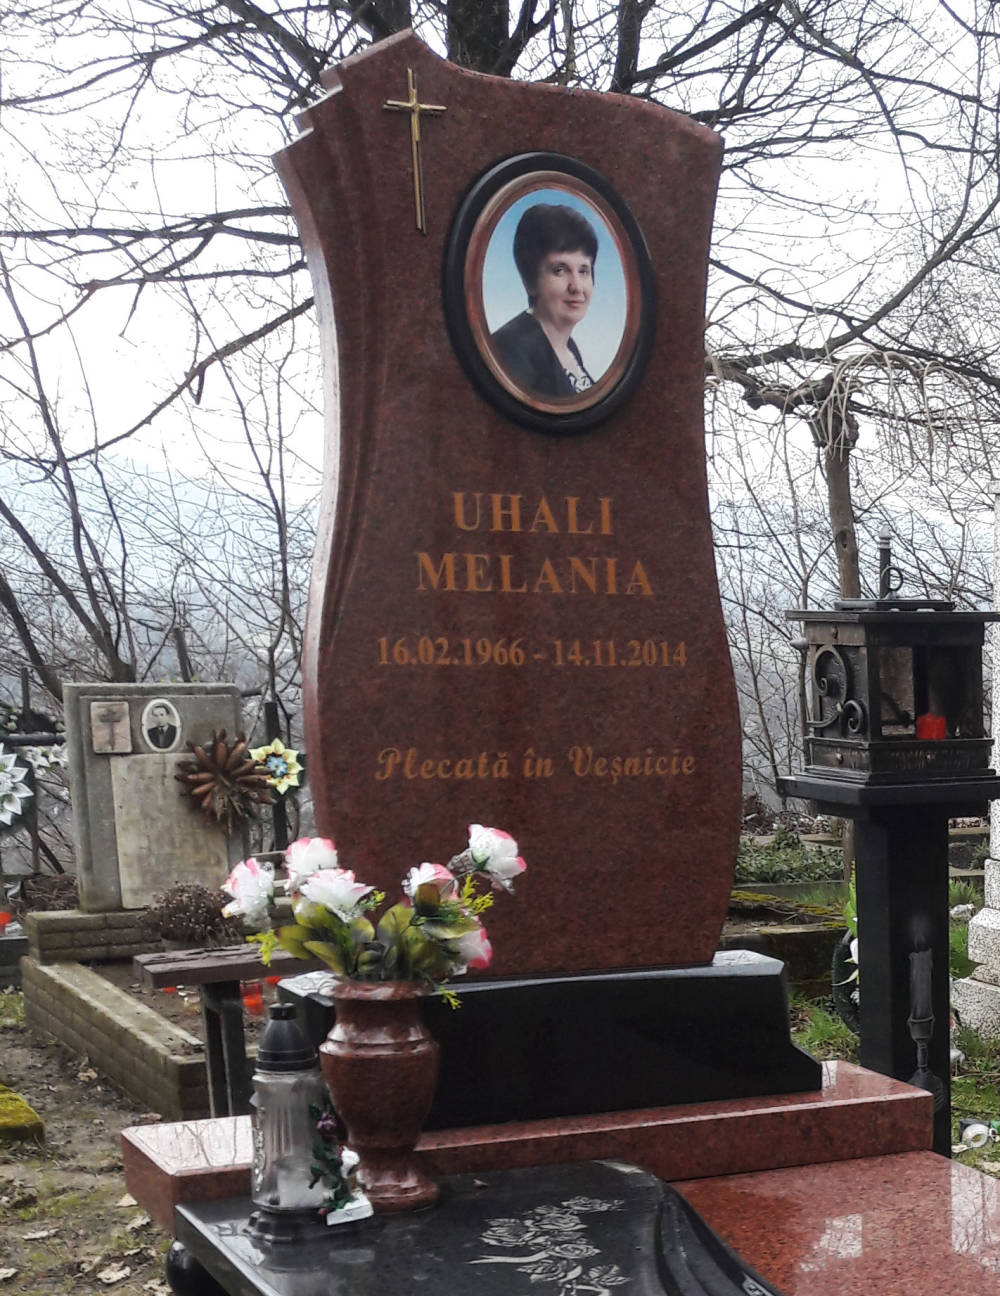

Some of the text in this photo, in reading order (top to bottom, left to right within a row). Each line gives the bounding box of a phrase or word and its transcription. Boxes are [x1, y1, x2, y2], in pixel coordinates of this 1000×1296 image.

[452, 491, 615, 536] UHALI
[415, 552, 656, 597] MELANIA
[376, 636, 526, 668] 16.02.1966
[552, 639, 688, 668] 14.11.2014
[375, 746, 510, 781] Plecată
[523, 746, 554, 778] în
